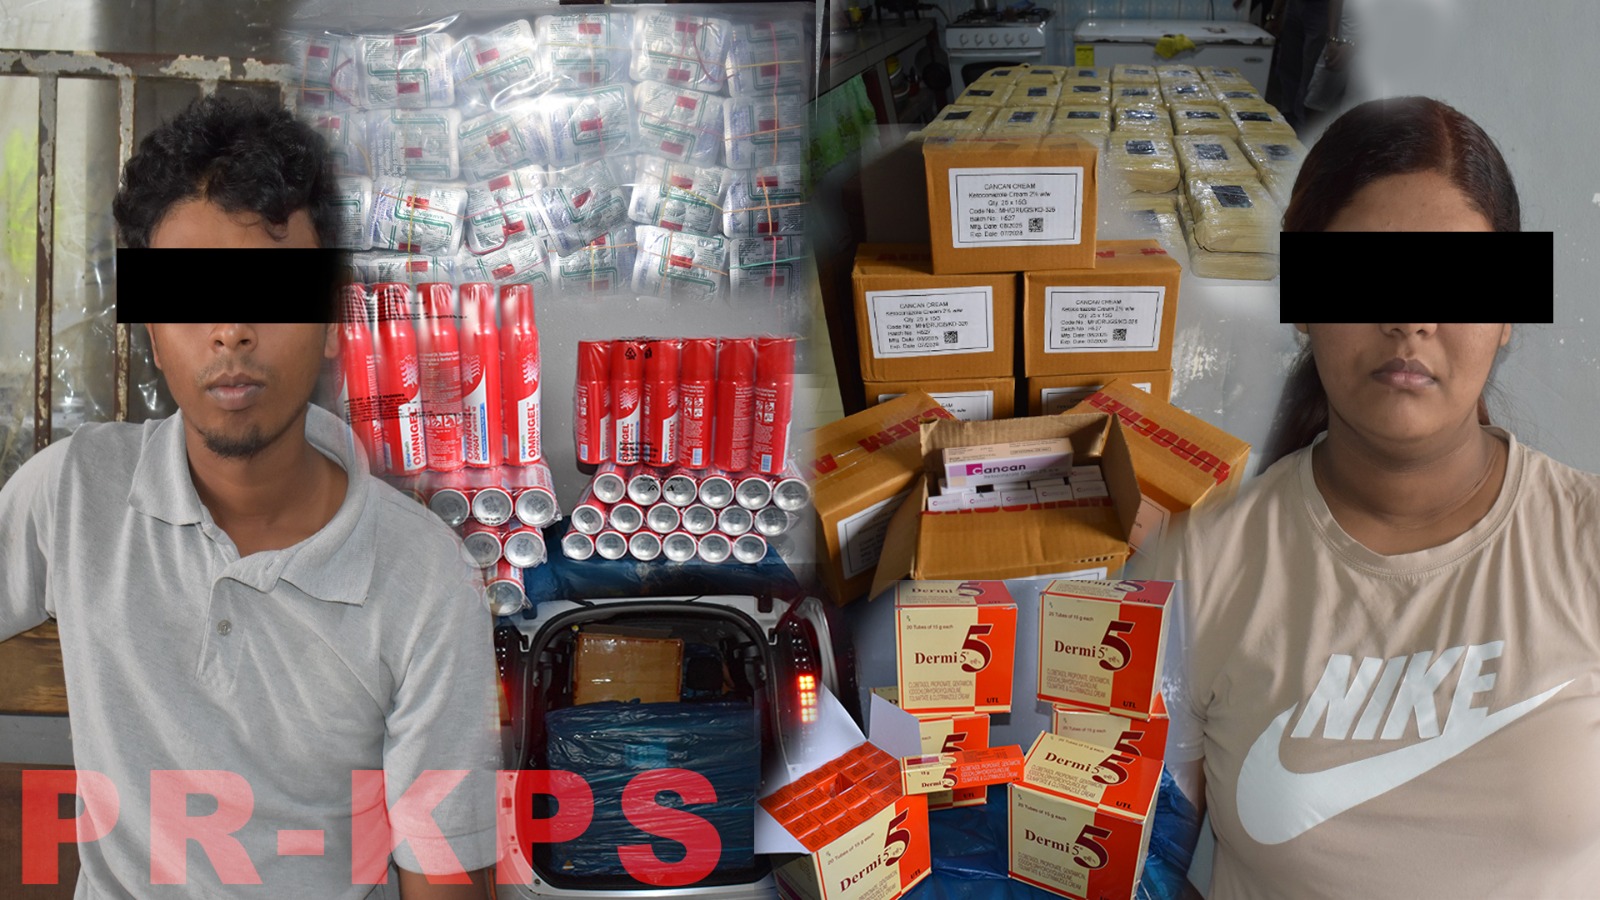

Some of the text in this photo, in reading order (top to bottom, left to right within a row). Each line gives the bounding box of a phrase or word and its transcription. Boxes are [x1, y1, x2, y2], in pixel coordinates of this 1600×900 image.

[409, 408, 421, 465] OMNIGEL
[465, 406, 473, 460] OMNIGEL
[528, 404, 536, 458] OMNIGEL
[915, 652, 957, 664] Dermi
[961, 624, 993, 673] 5
[1054, 639, 1096, 658] Dermi
[1098, 620, 1136, 672] 5
[1123, 700, 1136, 708] UTL
[1291, 640, 1505, 740] NIKE
[1044, 752, 1092, 772] Dermi
[1092, 754, 1135, 785] 5
[1025, 804, 1038, 813] Tubes
[1116, 800, 1131, 809] UTL
[884, 807, 911, 867] 5
[1025, 828, 1069, 853] Dermi
[1073, 824, 1112, 870] 5
[839, 854, 882, 892] Dermi
[910, 868, 921, 880] UTL
